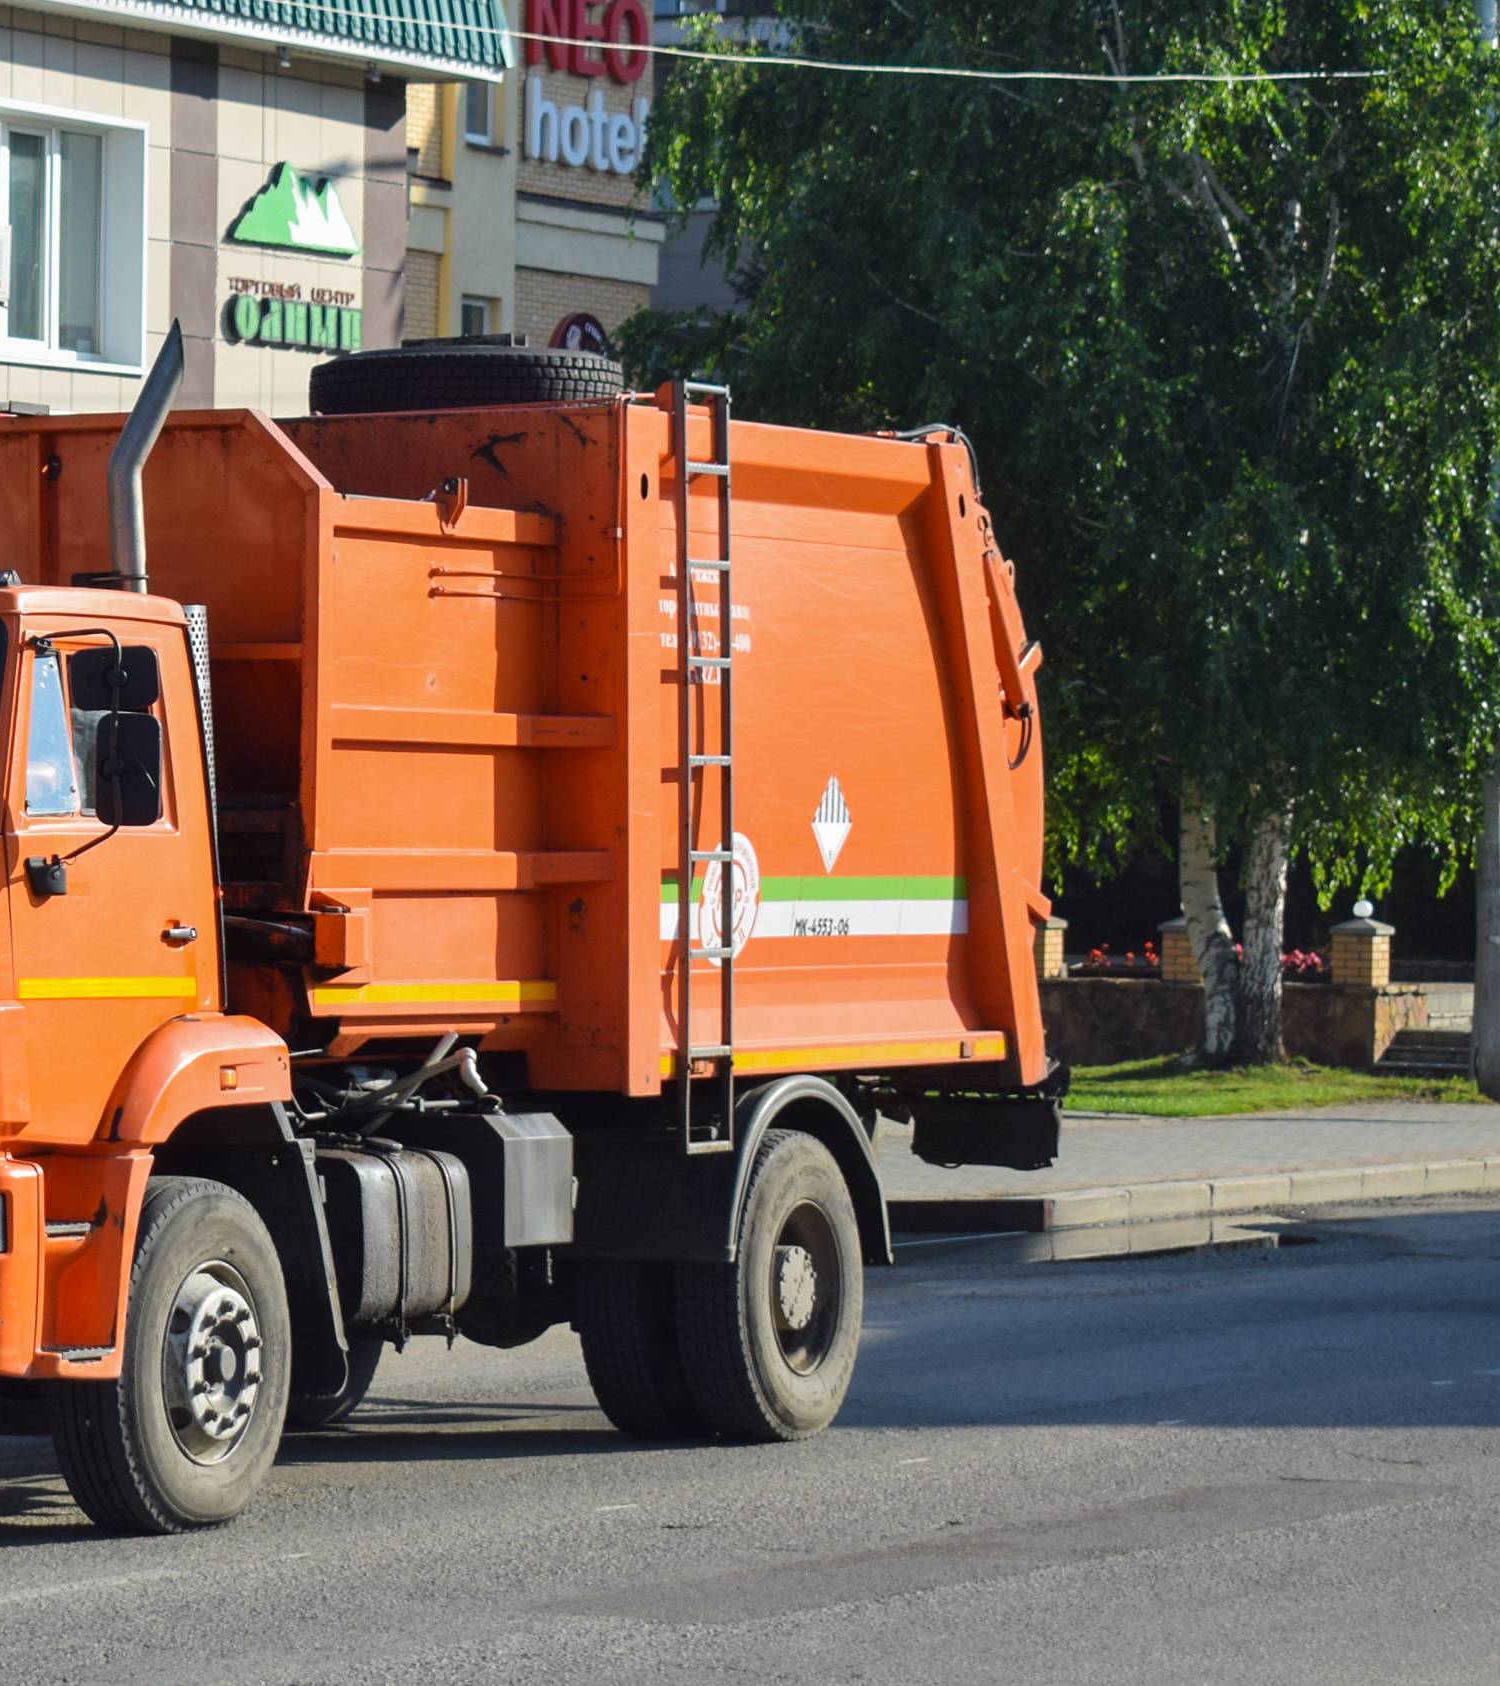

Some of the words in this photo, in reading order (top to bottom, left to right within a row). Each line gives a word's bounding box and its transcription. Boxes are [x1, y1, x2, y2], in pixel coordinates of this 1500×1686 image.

[526, 0, 649, 85] NEO
[525, 77, 649, 175] hotel
[228, 277, 301, 299] ТОРГОВЫЙ
[311, 287, 356, 305] ЦЕНТР
